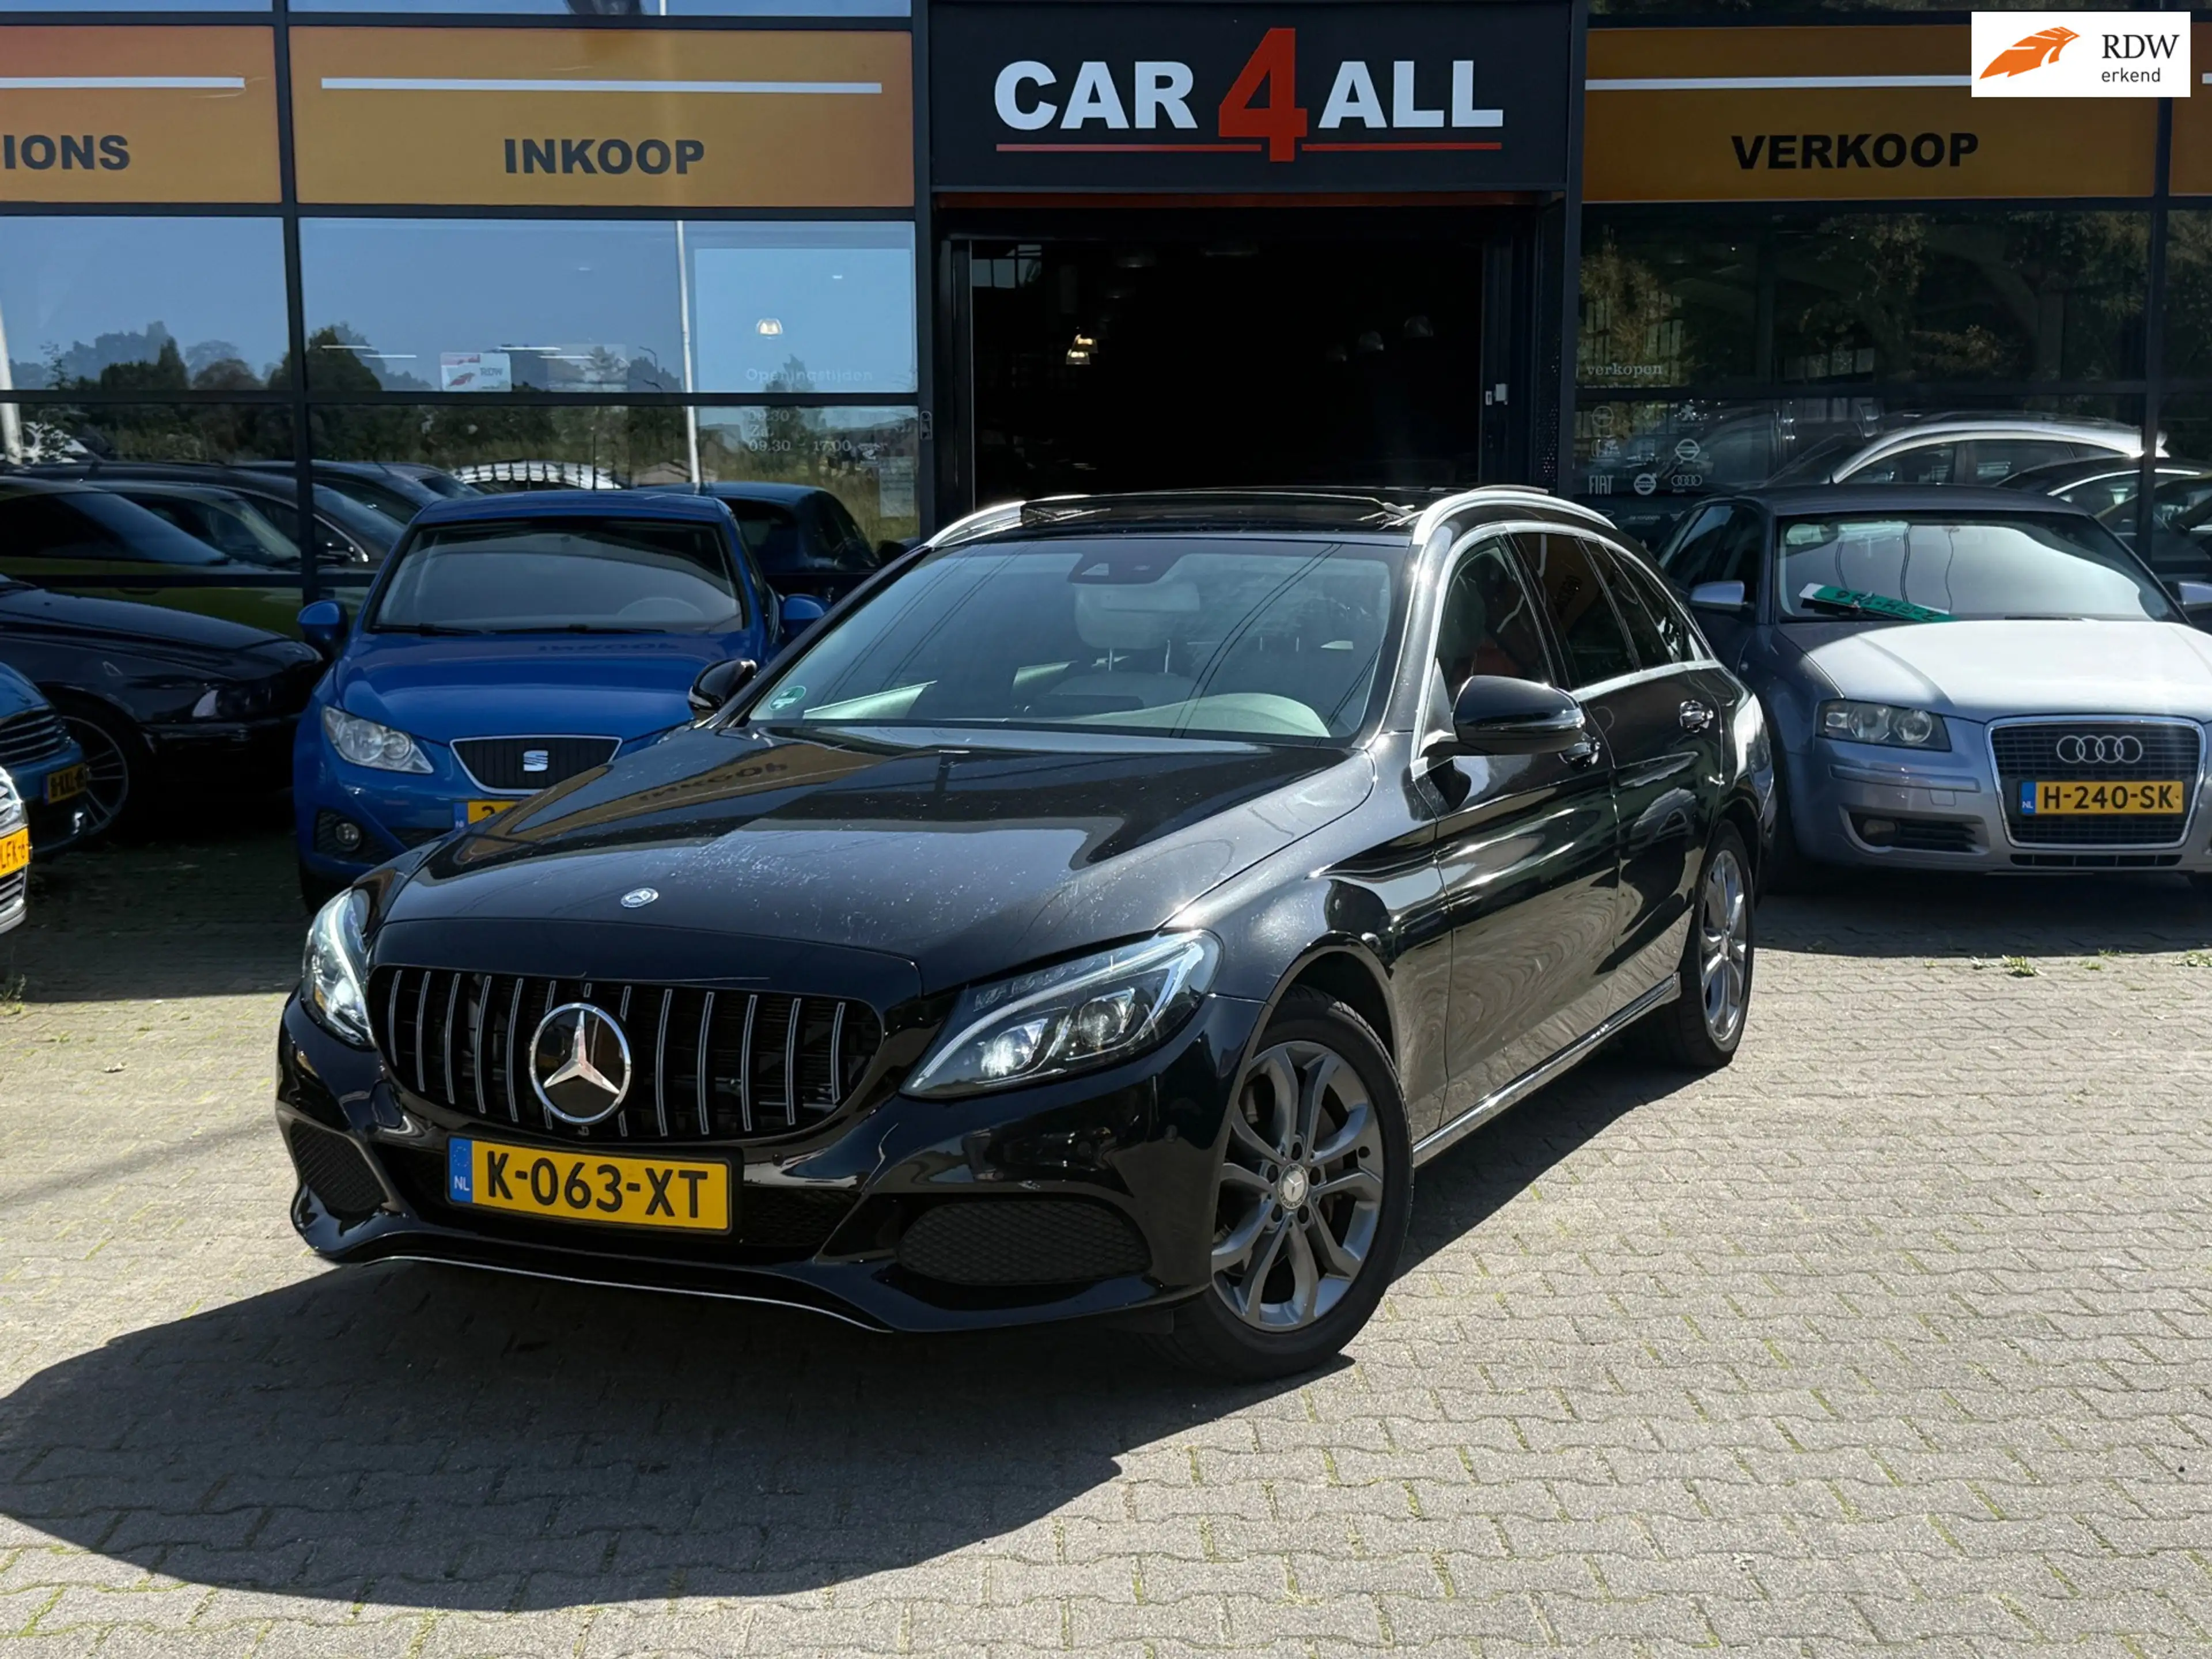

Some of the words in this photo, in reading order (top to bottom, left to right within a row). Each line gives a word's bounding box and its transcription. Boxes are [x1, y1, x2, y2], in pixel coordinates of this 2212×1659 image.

[994, 60, 1198, 131] CAR
[1218, 28, 1308, 162] 4
[1318, 59, 1503, 128] ALL
[3, 134, 130, 171] IONS
[503, 138, 704, 175] INKOOP
[1731, 132, 1979, 171] VERKOOP
[746, 369, 873, 384] Openingstijden
[1586, 362, 1662, 378] verkopen
[749, 440, 791, 452] 09.30
[1588, 475, 1615, 495] FIAT
[2022, 800, 2034, 809] NL
[2043, 785, 2173, 809] H-240-SK
[454, 1175, 470, 1192] NL
[487, 1150, 709, 1219] K-063-XT
